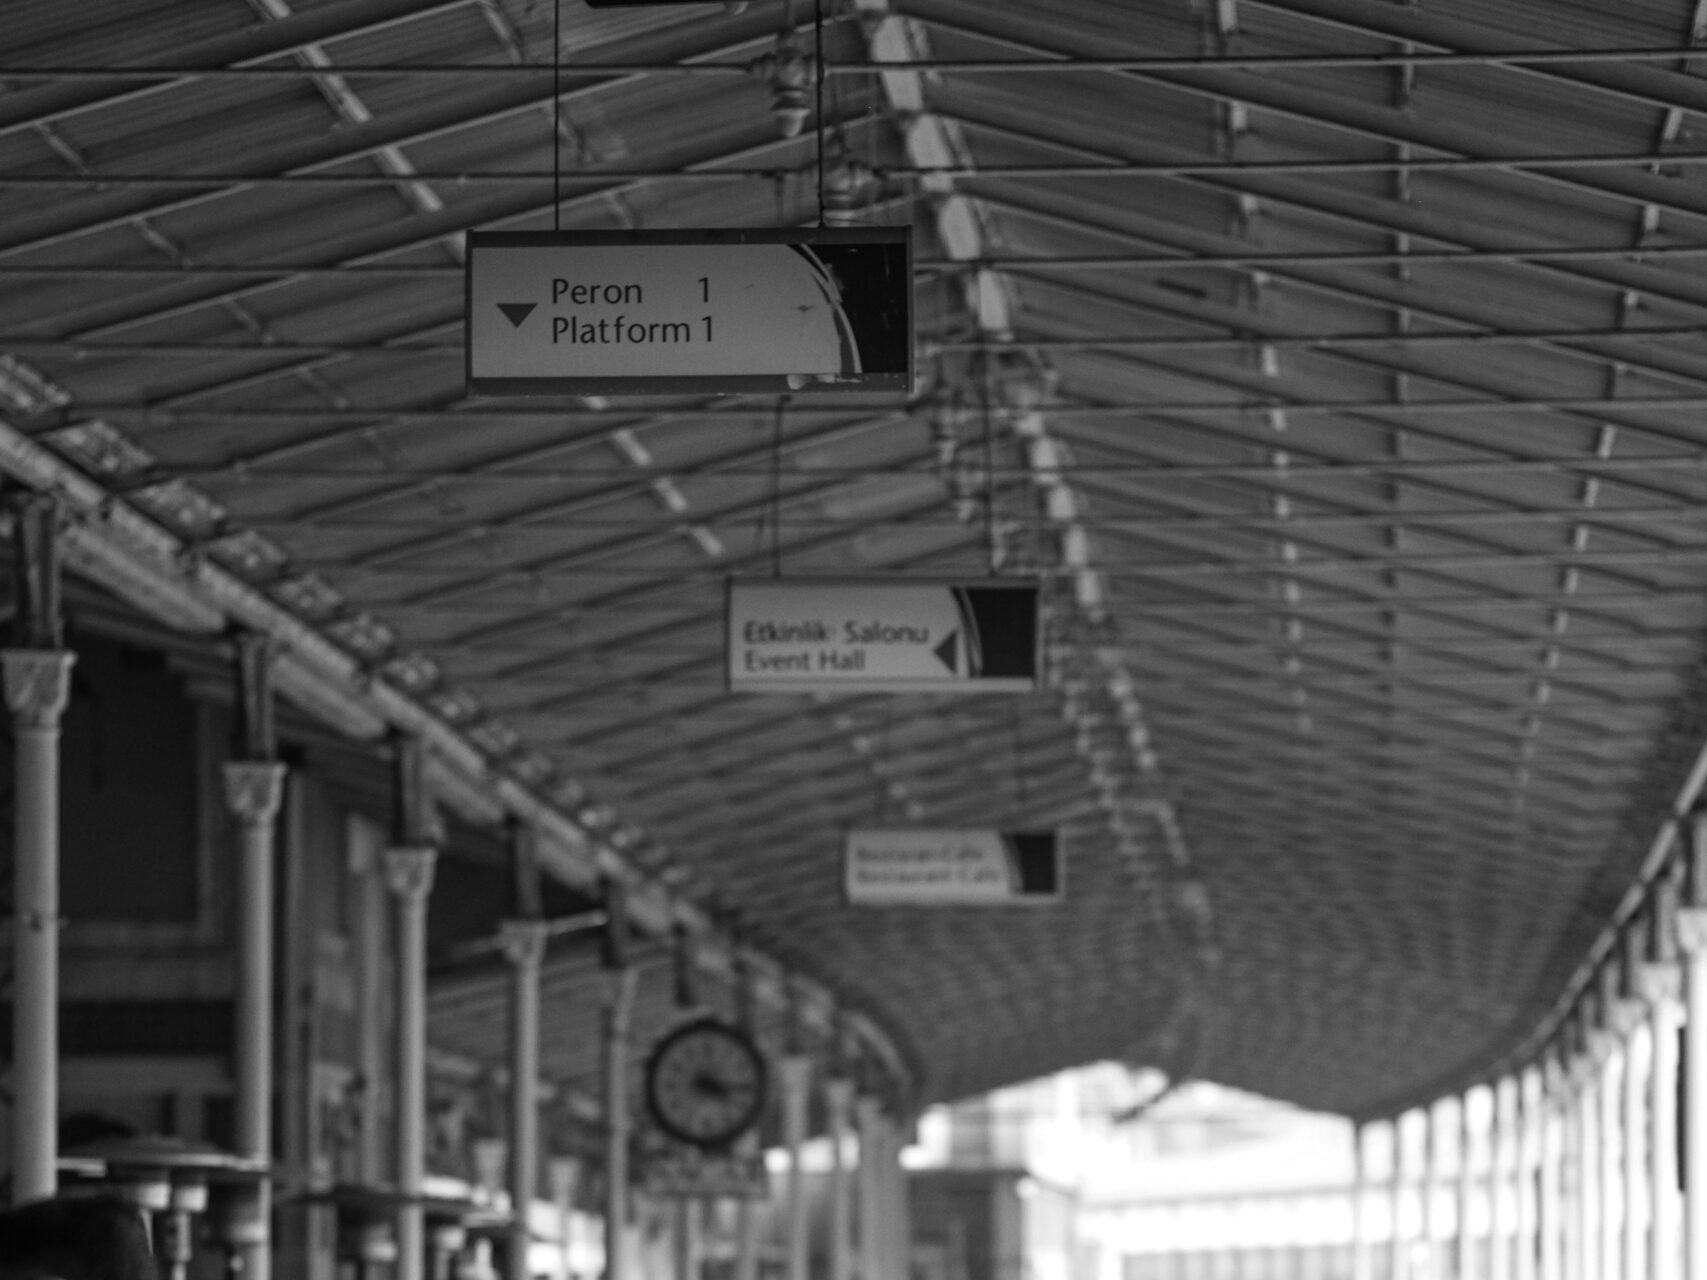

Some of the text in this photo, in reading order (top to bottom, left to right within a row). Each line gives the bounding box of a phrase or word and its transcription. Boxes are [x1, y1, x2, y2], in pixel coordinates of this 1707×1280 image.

[552, 277, 710, 304] Peron 1
[552, 315, 714, 344] Platform 1
[844, 619, 930, 645] Salonu
[744, 649, 867, 672] Event Hall
